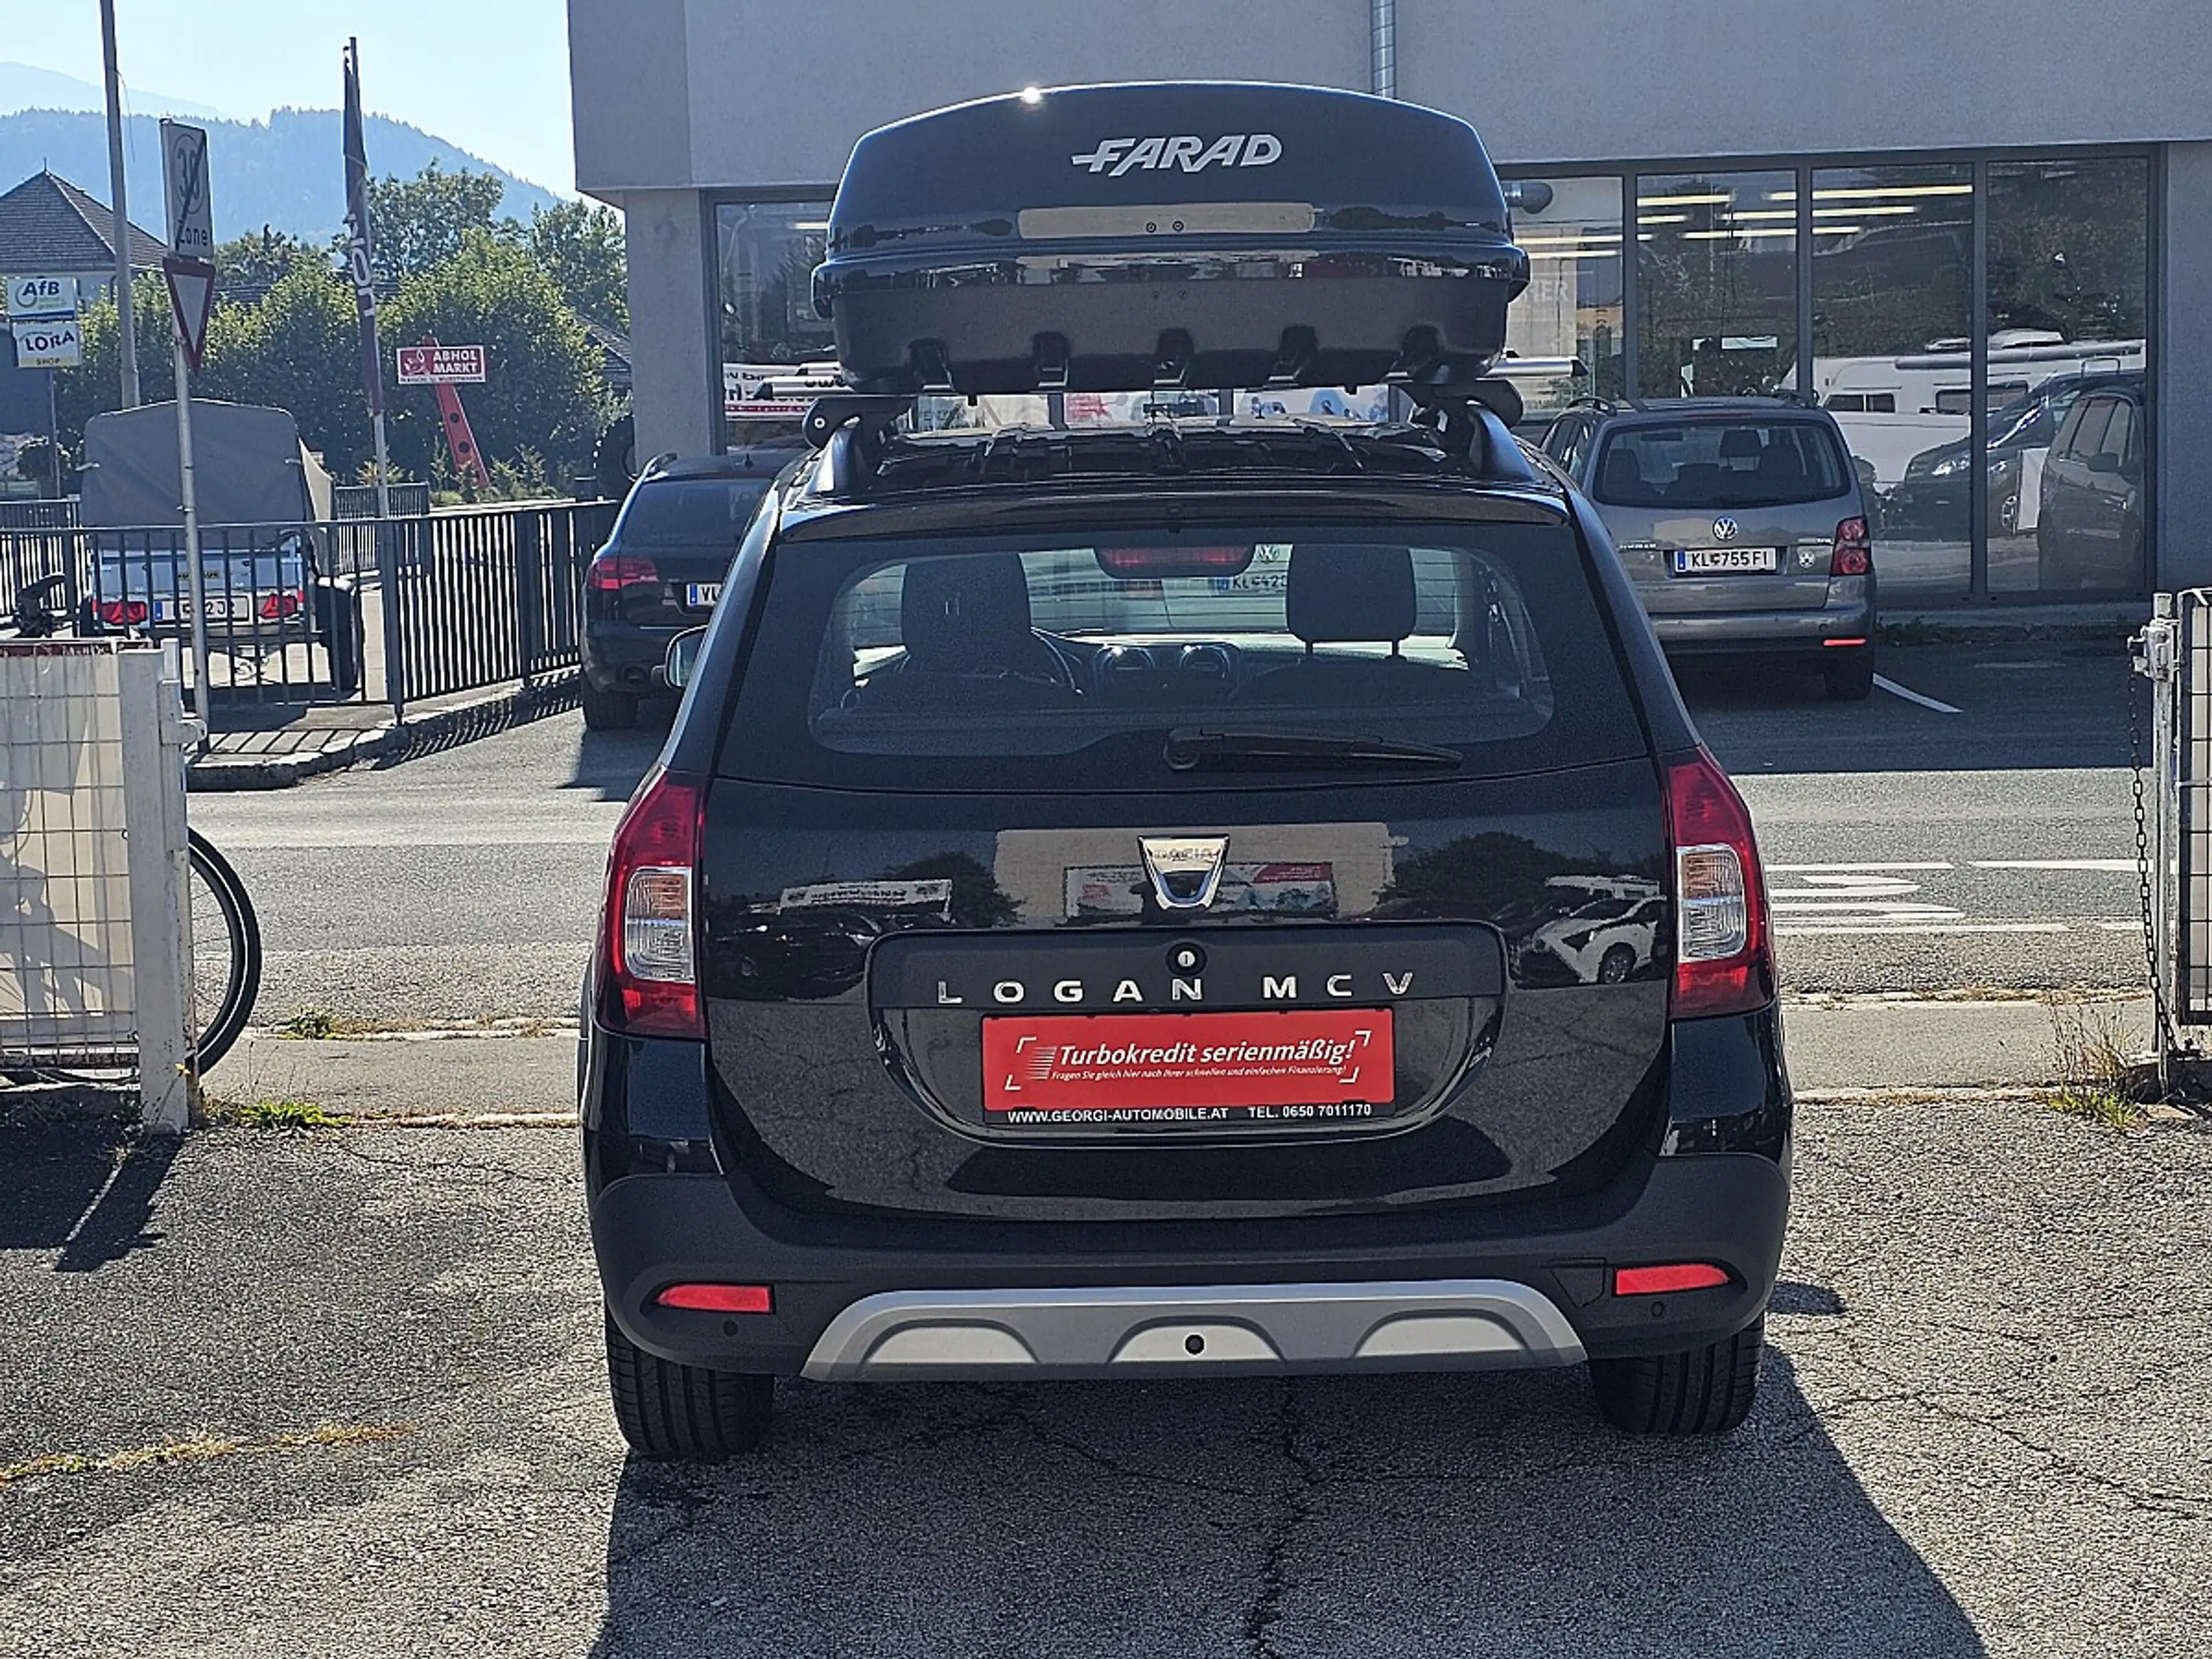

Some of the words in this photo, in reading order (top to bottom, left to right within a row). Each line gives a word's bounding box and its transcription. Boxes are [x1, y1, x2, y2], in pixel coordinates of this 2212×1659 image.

[1071, 134, 1282, 176] FARAD
[22, 281, 60, 296] AfB
[25, 330, 74, 351] LORA
[433, 350, 478, 361] ABHOL
[433, 363, 478, 373] MARKT
[938, 978, 1203, 1003] LOGAN
[1263, 972, 1414, 998] MCV
[1060, 1041, 1195, 1065] Turbokredit
[1200, 1038, 1355, 1065] serienmäßig!
[1051, 1070, 1081, 1081] Fragen
[1082, 1070, 1095, 1080] Sie
[1095, 1070, 1122, 1081] gleich
[1123, 1069, 1141, 1078] hier
[1141, 1069, 1162, 1078] nach
[1008, 1107, 1229, 1123] WWW.GEORGI-AUTOMOBILE.AT
[1248, 1107, 1279, 1119] TEL.
[1283, 1105, 1314, 1118] 0650
[1318, 1103, 1372, 1117] 7011170
